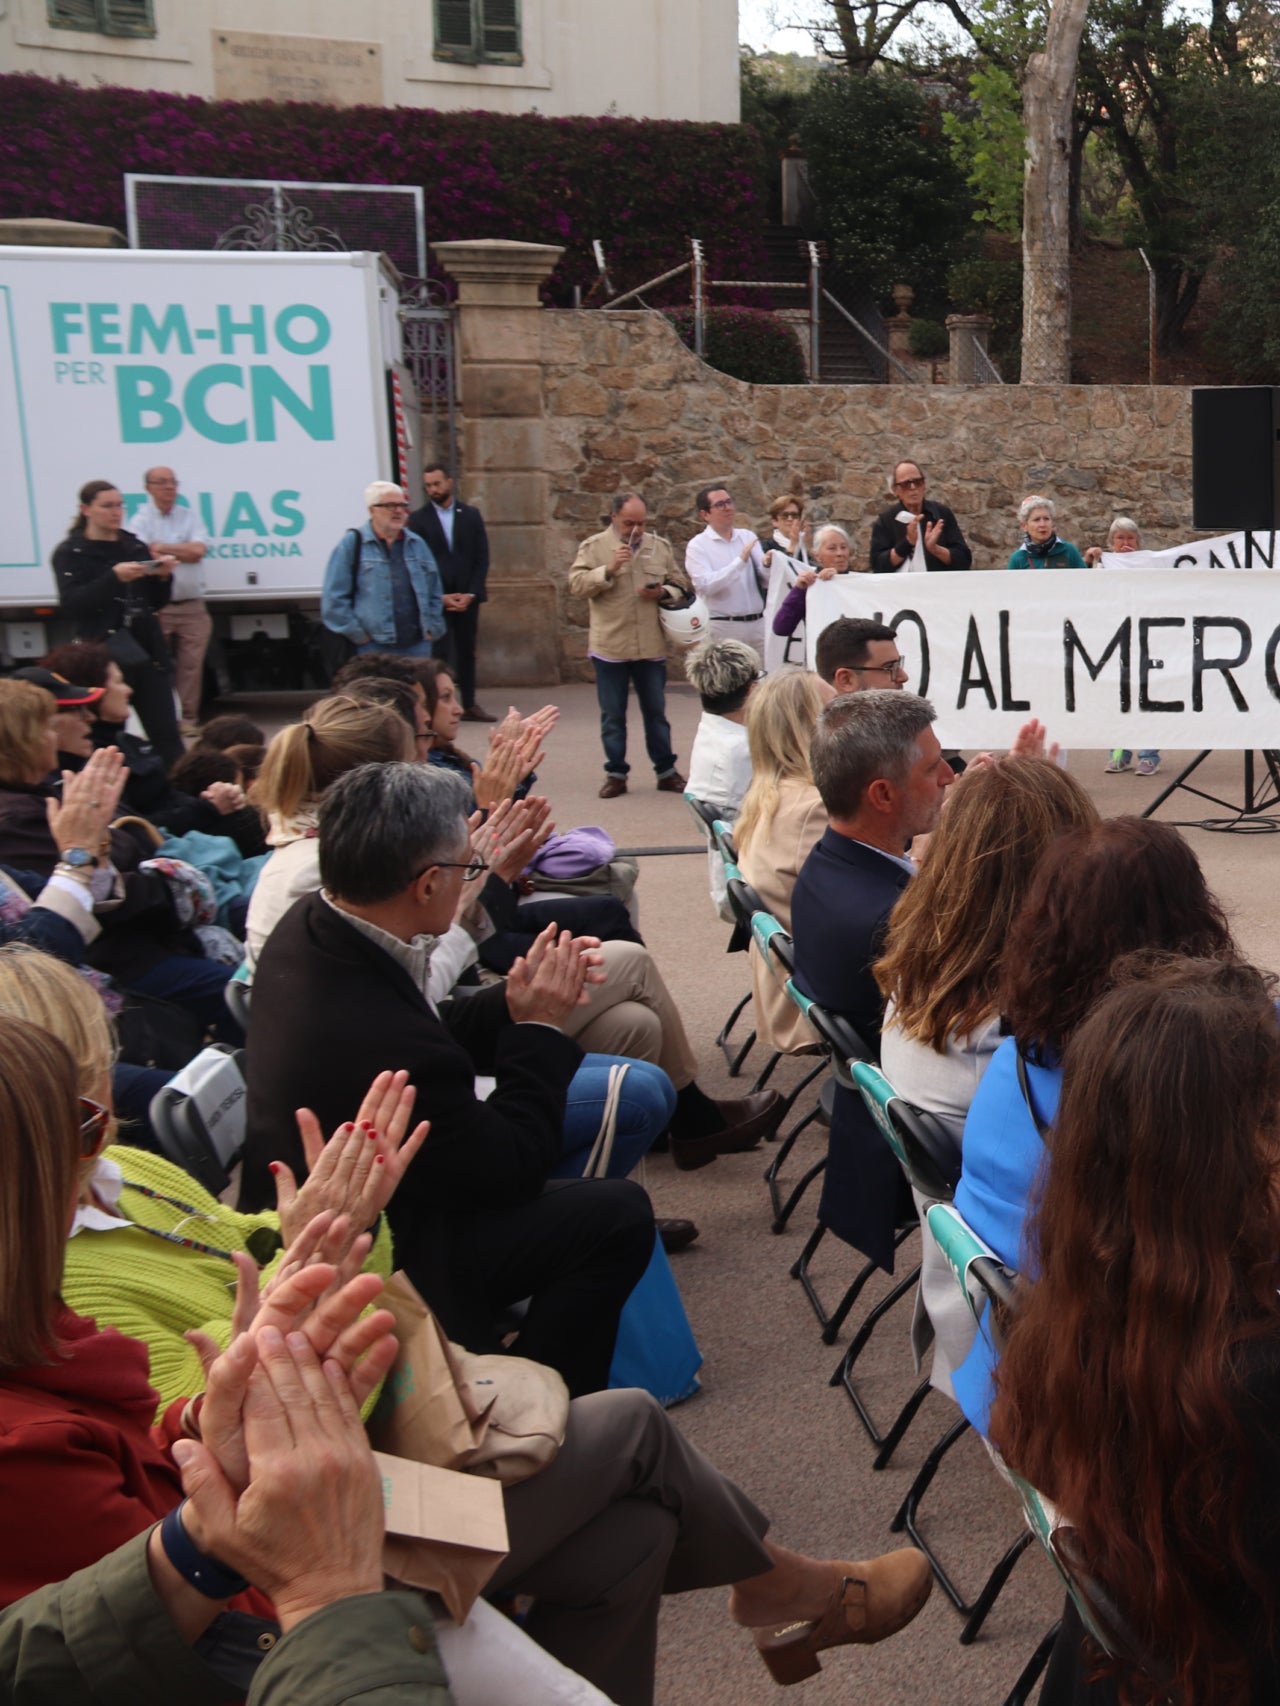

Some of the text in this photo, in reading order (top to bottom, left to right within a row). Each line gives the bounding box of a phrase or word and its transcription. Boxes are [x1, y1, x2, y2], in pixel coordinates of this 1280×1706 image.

[48, 301, 331, 355] FEM-HO
[54, 361, 335, 444] PER BCN
[121, 489, 306, 537] TIAS
[204, 542, 303, 559] RCELONA
[957, 610, 1031, 713] AL
